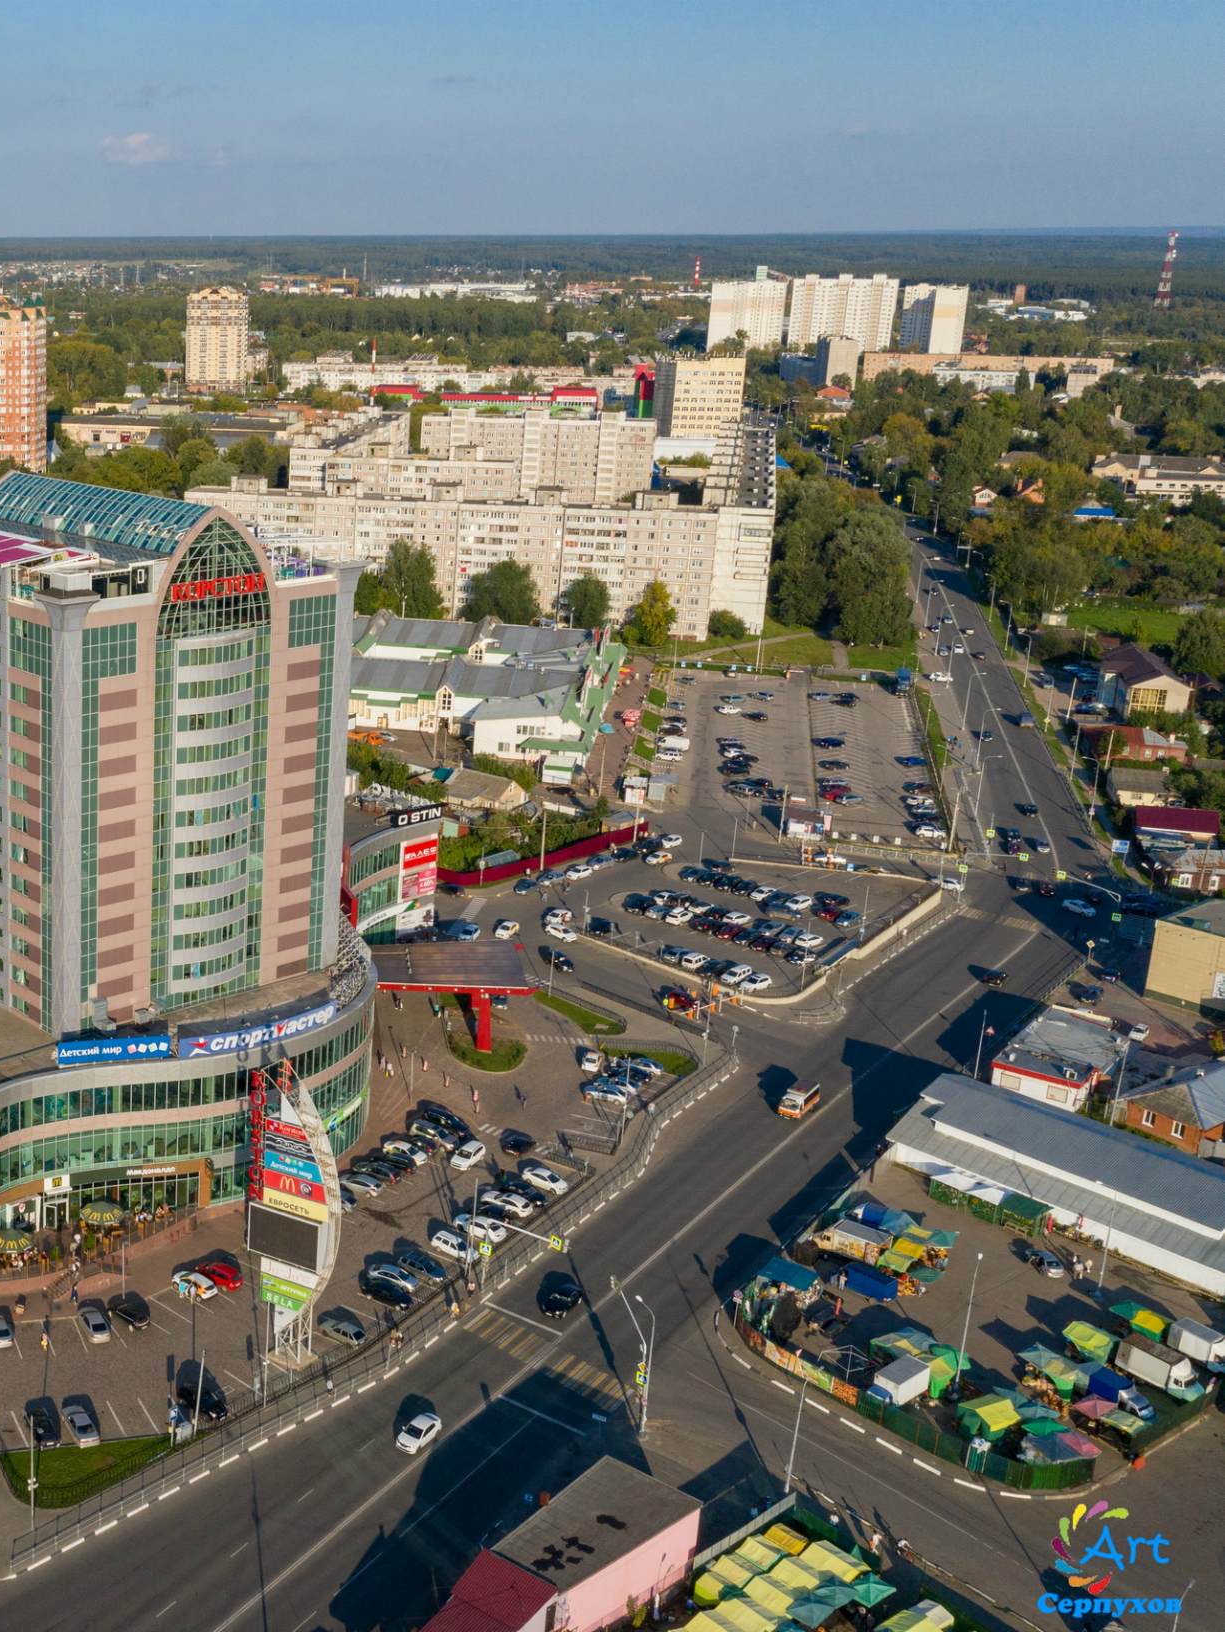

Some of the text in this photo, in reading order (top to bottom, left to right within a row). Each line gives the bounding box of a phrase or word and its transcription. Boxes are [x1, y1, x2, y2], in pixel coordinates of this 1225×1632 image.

[171, 572, 264, 604] КОРСТОН
[398, 807, 441, 826] O'STIN
[210, 1005, 335, 1051] спортмастер
[60, 1046, 122, 1058] Детский мир
[268, 1196, 310, 1215] ЕВРОСЕТЬ
[265, 1291, 293, 1309] SELA
